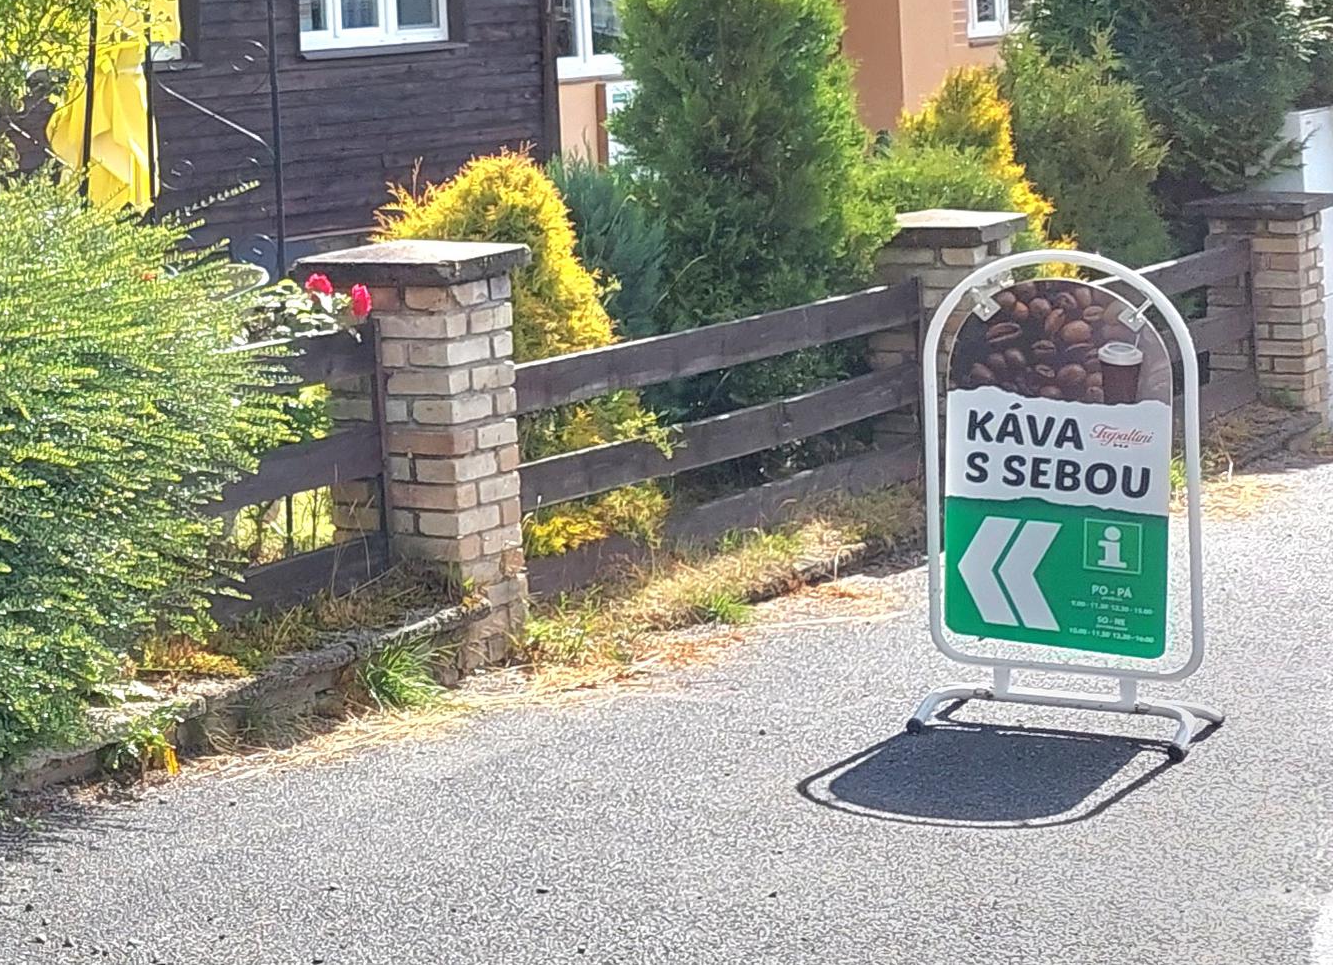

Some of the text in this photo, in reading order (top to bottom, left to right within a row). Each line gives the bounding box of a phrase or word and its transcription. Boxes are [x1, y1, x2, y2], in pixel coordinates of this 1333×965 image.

[967, 403, 1084, 451] KÁVA
[965, 452, 1151, 498] S SEBOU
[1092, 585, 1108, 595] PO
[1097, 616, 1108, 624] SO
